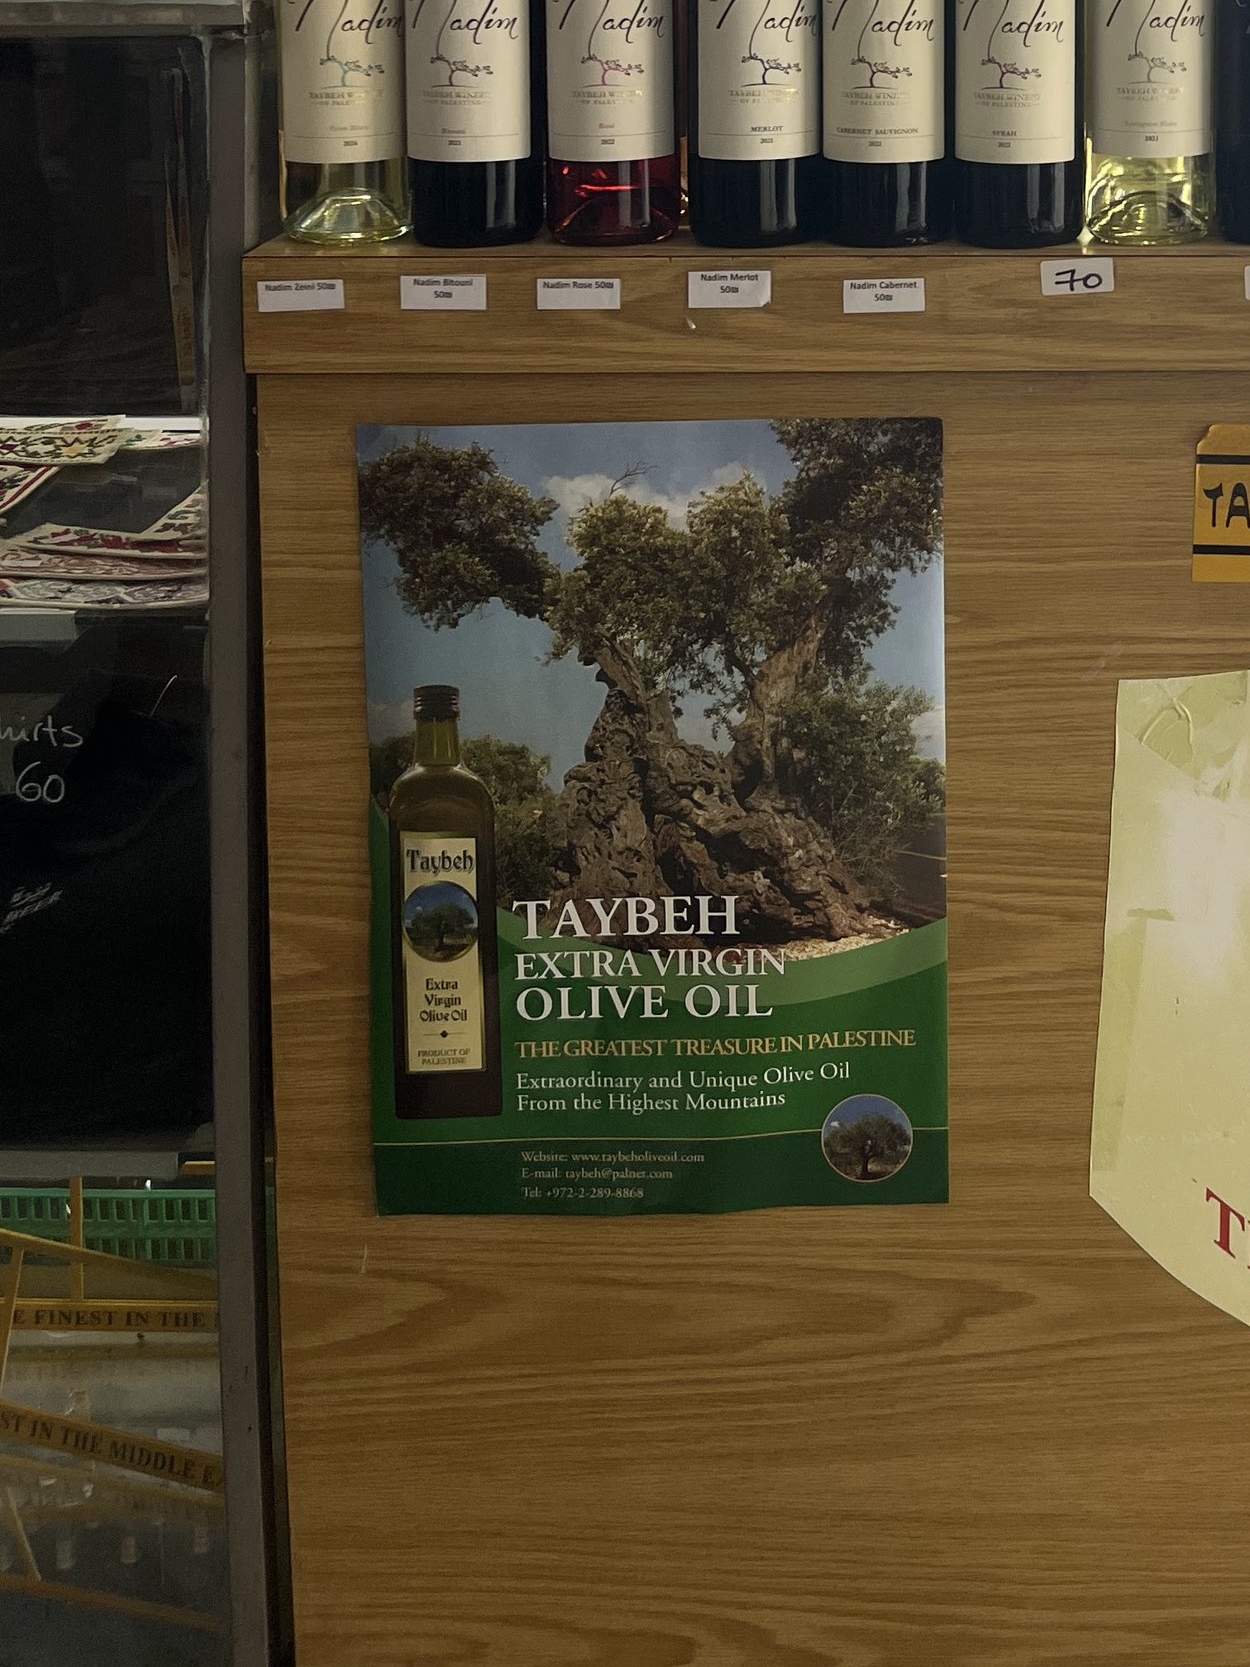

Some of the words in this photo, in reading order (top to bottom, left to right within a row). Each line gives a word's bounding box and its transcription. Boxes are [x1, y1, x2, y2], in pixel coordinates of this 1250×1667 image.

[750, 125, 784, 133] MERLOT
[836, 127, 872, 135] CABERNET
[875, 126, 919, 135] SAUVIGNON
[543, 281, 571, 289] Nadim
[572, 281, 593, 289] Rose
[701, 273, 729, 282] Nadim
[730, 273, 759, 282] Merlot
[850, 281, 878, 290] Nadim
[879, 280, 918, 290] Cabernet
[1054, 269, 1103, 291] 70
[16, 761, 65, 803] 60
[407, 848, 475, 877] Taybeh
[513, 895, 741, 942] TAYBEH
[515, 949, 642, 980] EXTRA
[648, 947, 786, 977] VIRGIN
[425, 978, 458, 991] Extra
[424, 994, 462, 1008] Virgin
[515, 984, 669, 1021] OLIVE
[684, 984, 774, 1018] OIL
[419, 1009, 449, 1023] Olive
[450, 1009, 468, 1022] Oil
[515, 1041, 560, 1059] THE
[563, 1038, 668, 1058] GREATEST
[673, 1037, 777, 1057] TREASURE
[780, 1034, 804, 1053] IN
[807, 1029, 917, 1050] PALESTINE
[417, 1049, 458, 1058] PRODUCT
[458, 1048, 471, 1056] OF
[421, 1056, 467, 1066] PALESTINE
[516, 1071, 643, 1094] Extraordinary
[648, 1072, 682, 1089] and
[689, 1071, 758, 1092] Unique
[763, 1065, 815, 1086] Olive
[820, 1061, 850, 1081] Oil
[517, 1094, 567, 1111] From
[573, 1093, 602, 1110] the
[608, 1093, 679, 1116] Highest
[685, 1091, 786, 1111] Mountains
[521, 1150, 568, 1163] Website:
[565, 1167, 673, 1183] taybeh@palnet.com
[34, 1308, 118, 1327] FINEST
[125, 1310, 150, 1327] IN
[158, 1310, 206, 1328] THE
[30, 1419, 54, 1438] IN
[60, 1428, 102, 1455] THE
[109, 1439, 197, 1476] MIDDLE
